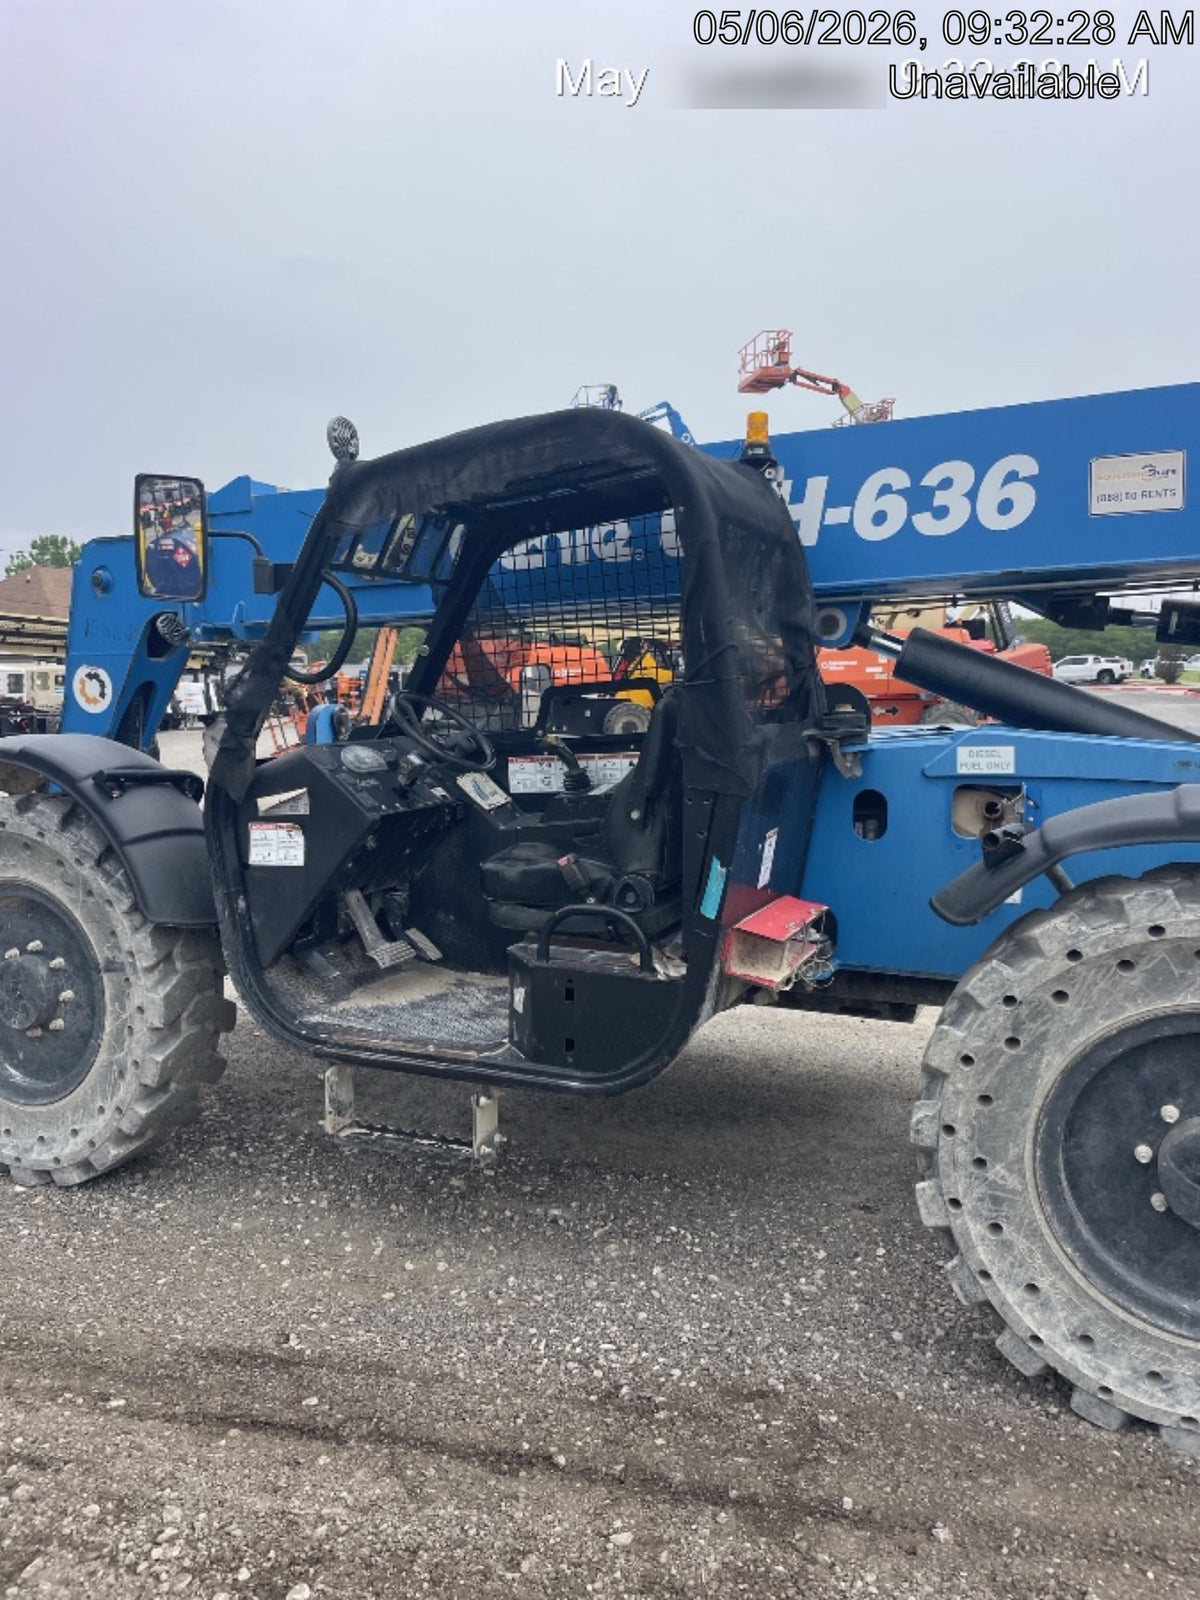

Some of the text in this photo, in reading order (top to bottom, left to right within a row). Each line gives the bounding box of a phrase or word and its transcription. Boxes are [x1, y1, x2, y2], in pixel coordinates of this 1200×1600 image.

[968, 749, 1003, 758] DIESEL
[960, 761, 1011, 770] FUEL ONLY
